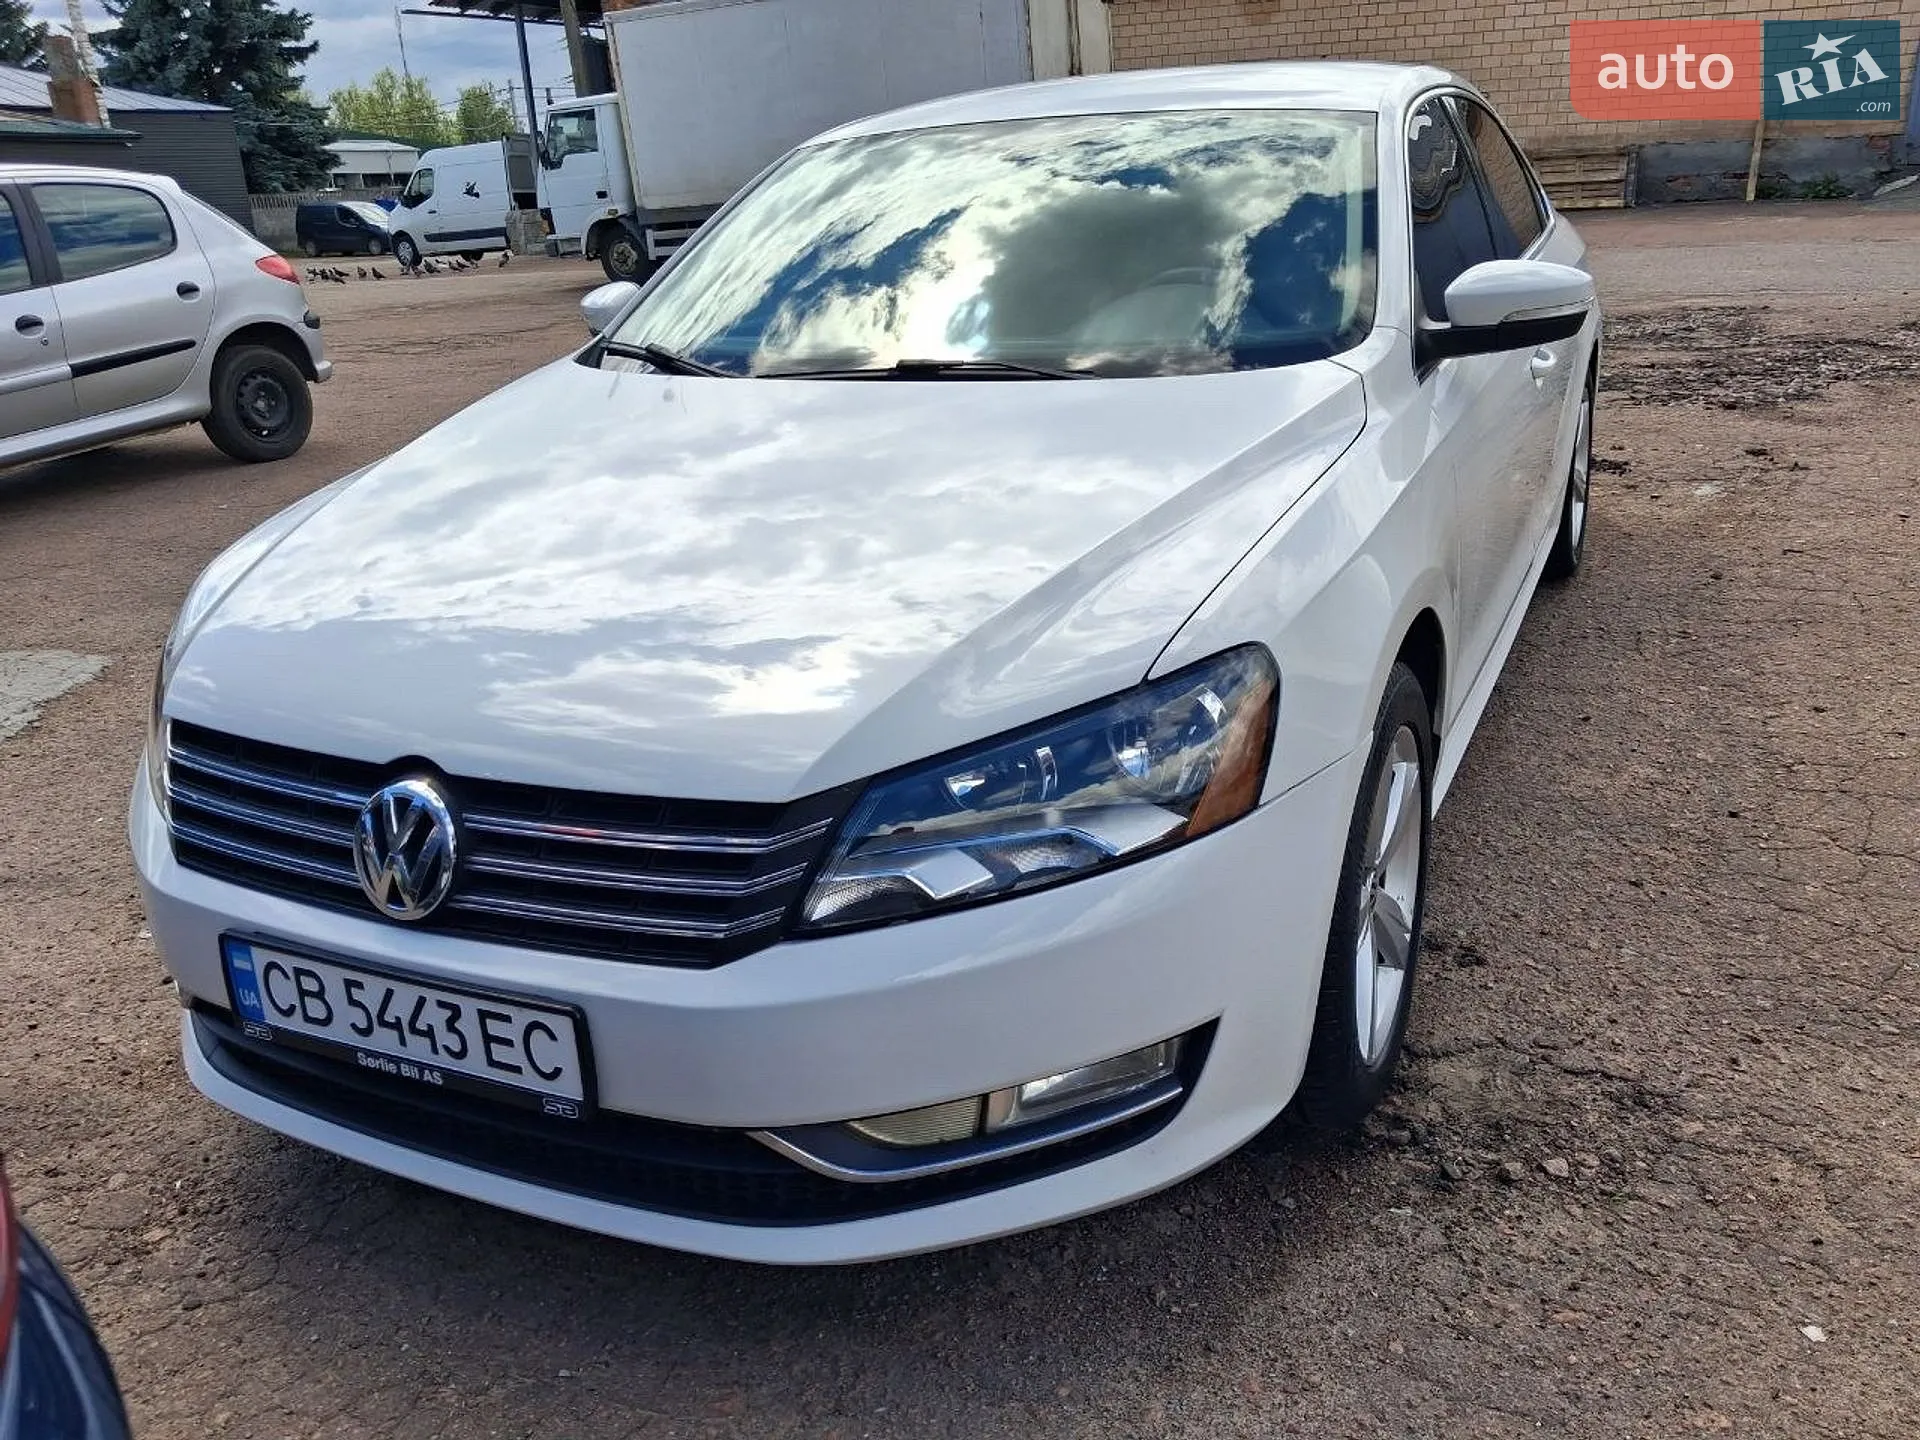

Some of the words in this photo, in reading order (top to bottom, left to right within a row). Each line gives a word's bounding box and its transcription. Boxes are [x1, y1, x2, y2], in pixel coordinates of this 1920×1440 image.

[239, 989, 260, 1008] UA
[263, 961, 334, 1027] CB
[343, 978, 469, 1060] 5443
[477, 1008, 563, 1081] EC
[401, 1063, 421, 1081] Bil
[423, 1068, 444, 1086] AS
